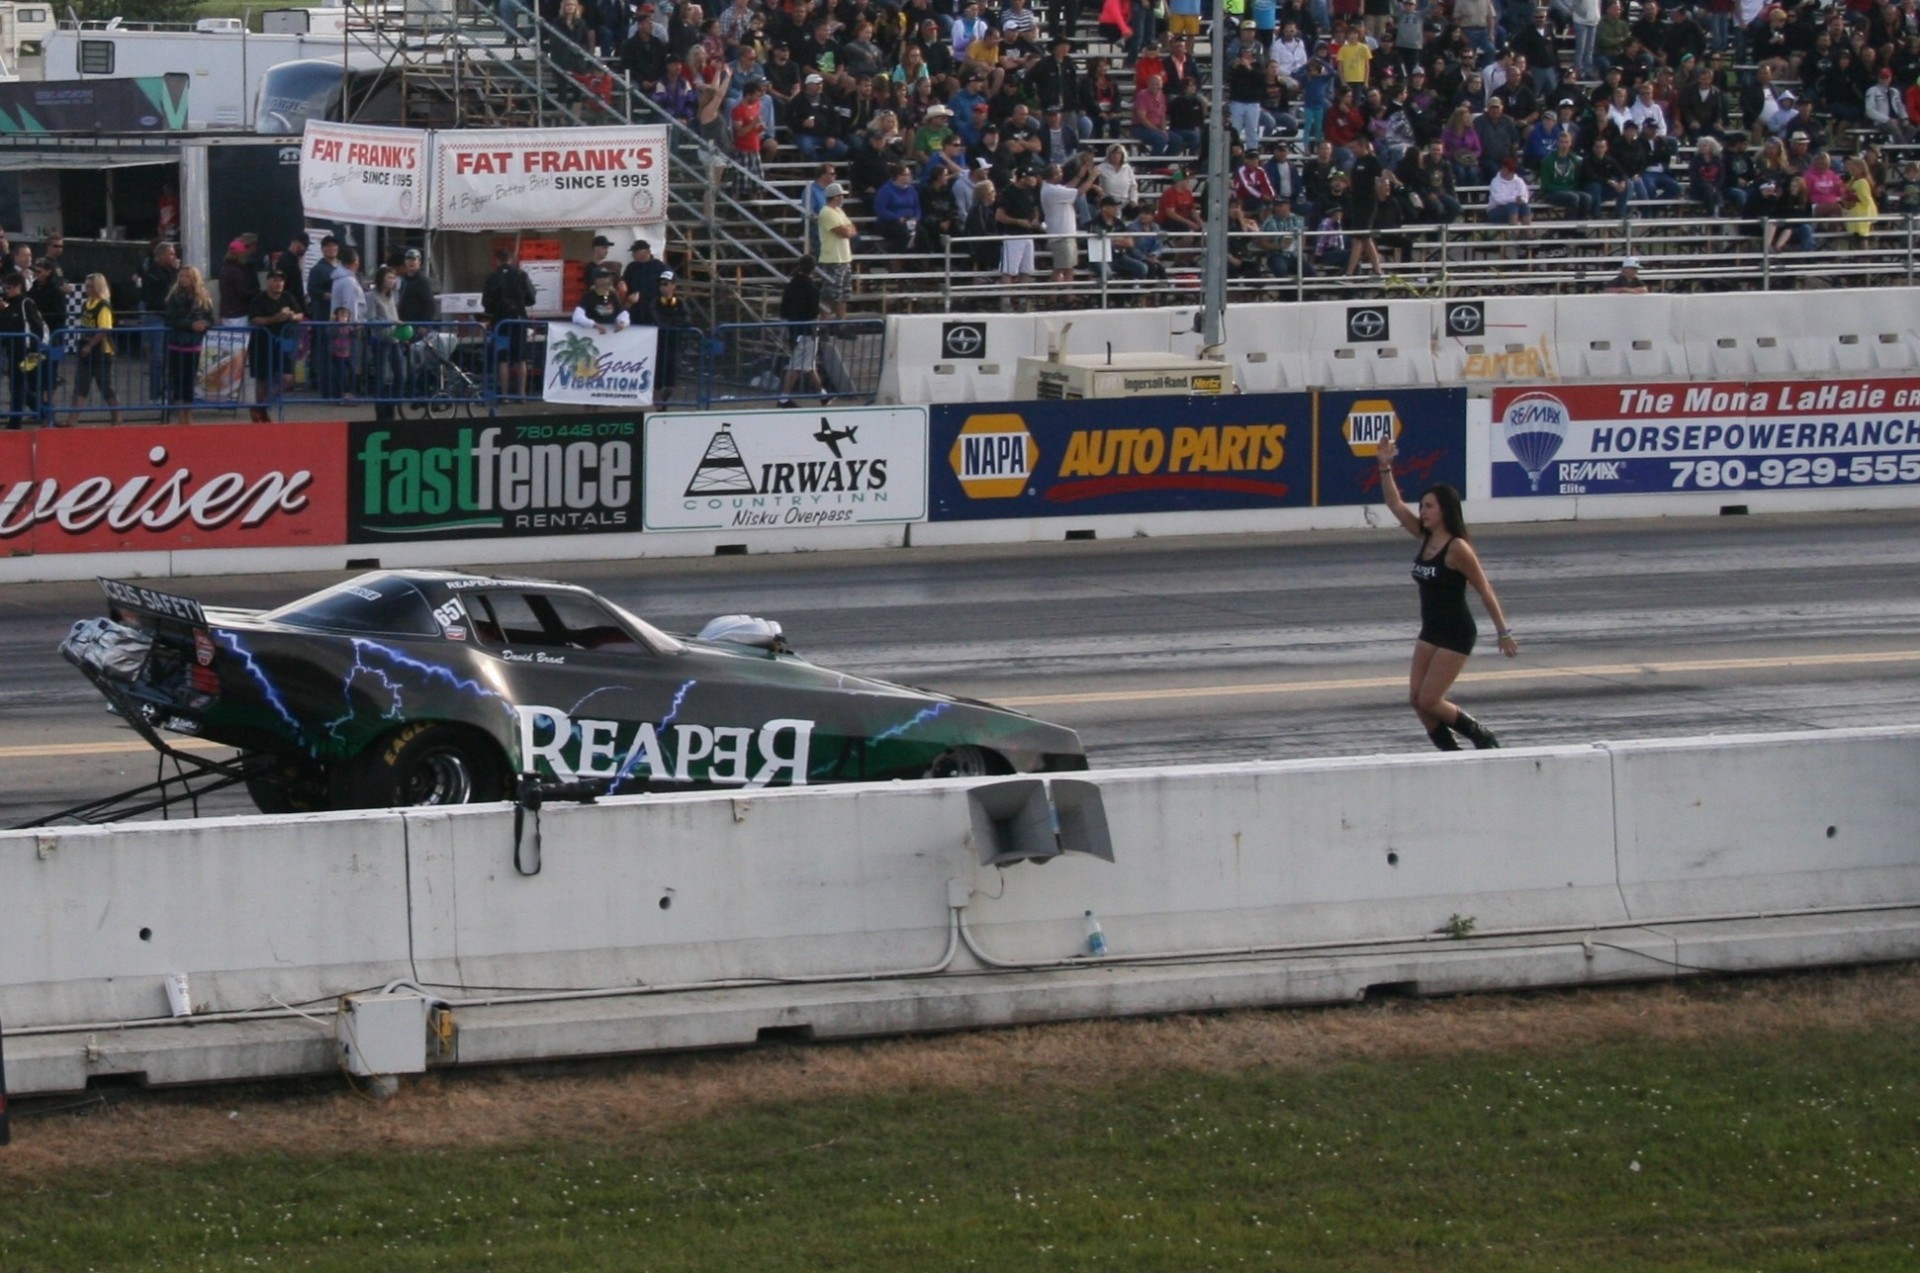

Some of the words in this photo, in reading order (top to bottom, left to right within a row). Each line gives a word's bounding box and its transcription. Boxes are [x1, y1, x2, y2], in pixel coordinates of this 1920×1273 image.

[311, 138, 343, 162] FAT
[347, 143, 415, 169] FRANK'S
[456, 152, 513, 175] FAT
[523, 147, 653, 173] FRANK'S
[362, 170, 390, 185] SINCE
[554, 175, 606, 190] SINCE
[612, 174, 649, 187] 1995
[592, 352, 648, 379] Good
[1619, 389, 1674, 414] The
[1683, 387, 1767, 412] Mona
[1778, 384, 1886, 411] LaHaie
[516, 426, 553, 438] 780
[557, 424, 593, 437] 448
[597, 422, 635, 436] 0715
[1352, 414, 1392, 441] NAPA
[1591, 419, 1920, 453] HORSEPOWERRANCH
[964, 436, 1025, 476] NAPA
[1058, 427, 1165, 477] AUTO
[1168, 424, 1286, 473] PARTS
[1559, 461, 1620, 481] RE/MAX
[684, 495, 822, 510] COUNTRY
[837, 492, 888, 503] INN
[1560, 483, 1587, 494] Elite
[516, 511, 627, 528] RENTALS
[732, 510, 779, 527] Nisku
[784, 507, 853, 526] Overpass
[141, 589, 204, 622] SAFETY
[432, 597, 467, 627] 657
[502, 649, 534, 662] David
